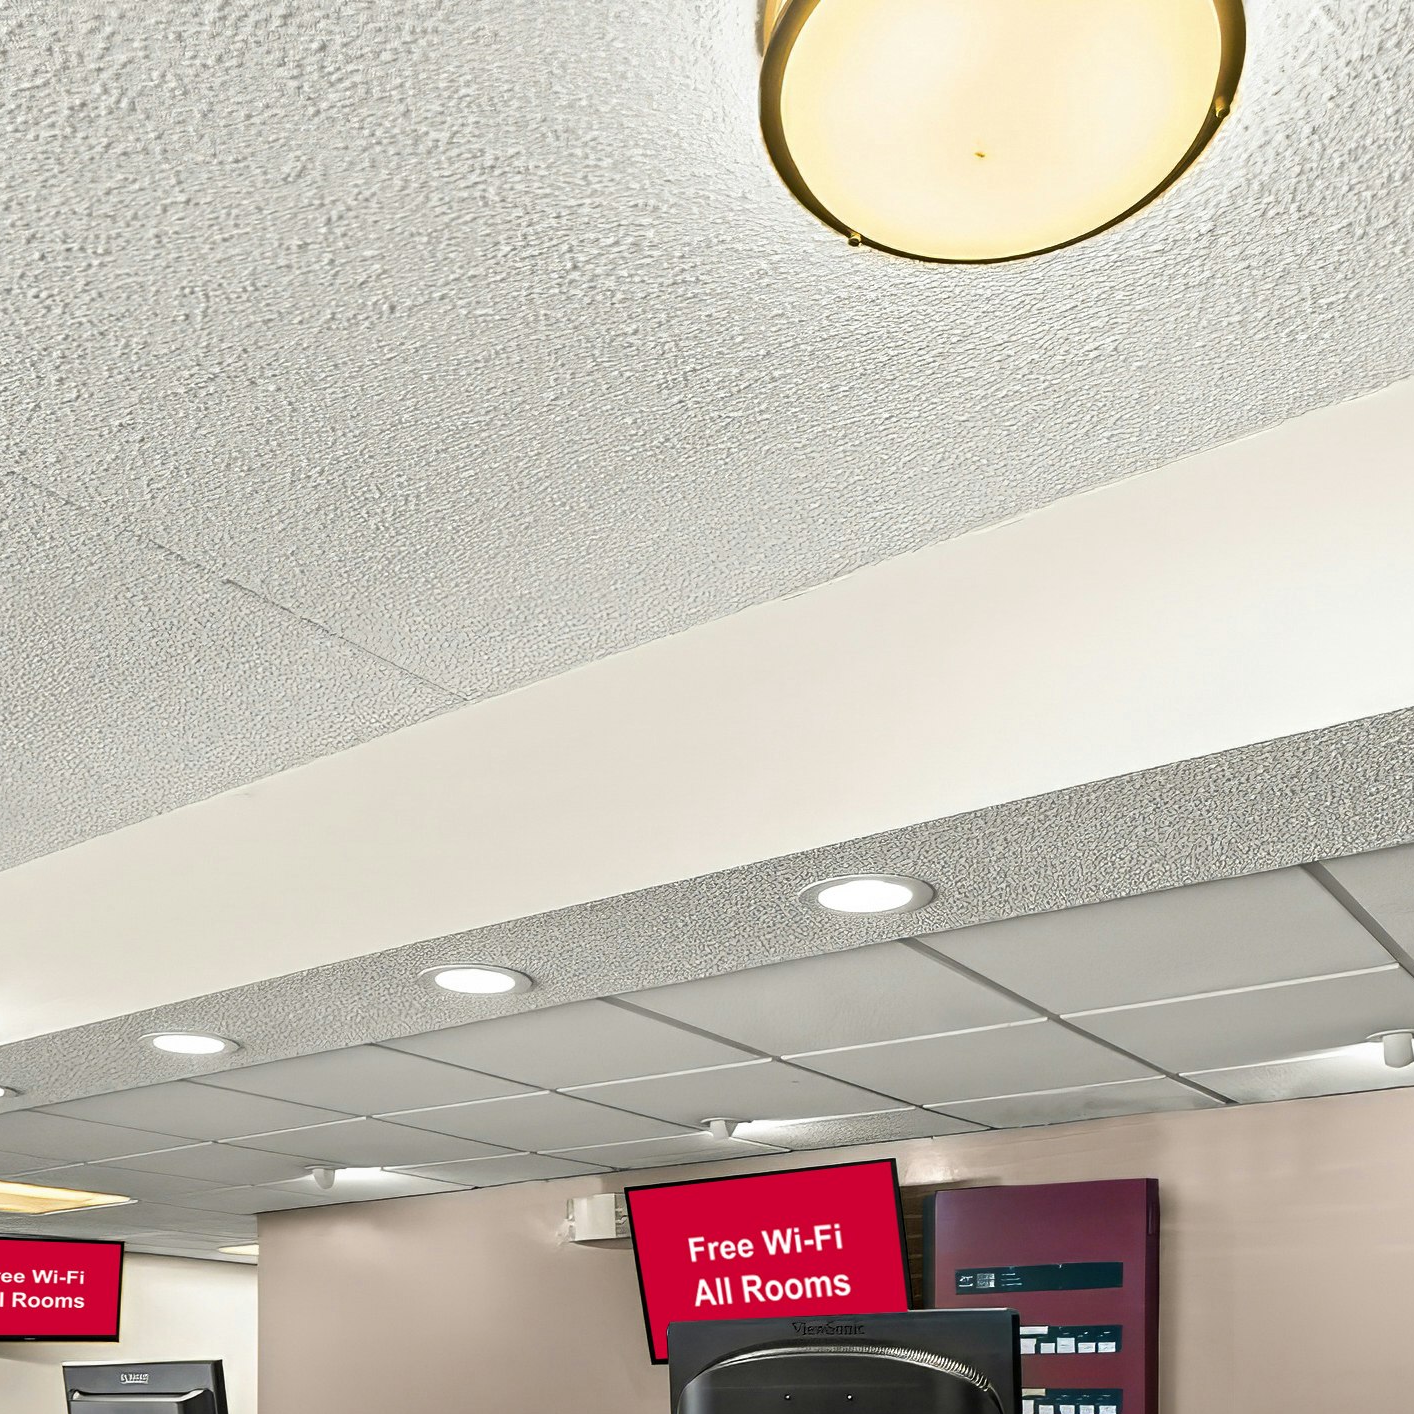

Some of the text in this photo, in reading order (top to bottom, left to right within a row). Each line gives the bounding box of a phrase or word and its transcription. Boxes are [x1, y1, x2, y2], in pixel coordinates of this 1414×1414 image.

[688, 1223, 843, 1263] Free Wi-Fi
[32, 1269, 85, 1285] Wi-Fi
[694, 1274, 851, 1307] All Rooms
[12, 1292, 85, 1309] Rooms
[791, 1321, 866, 1336] ViewSonic
